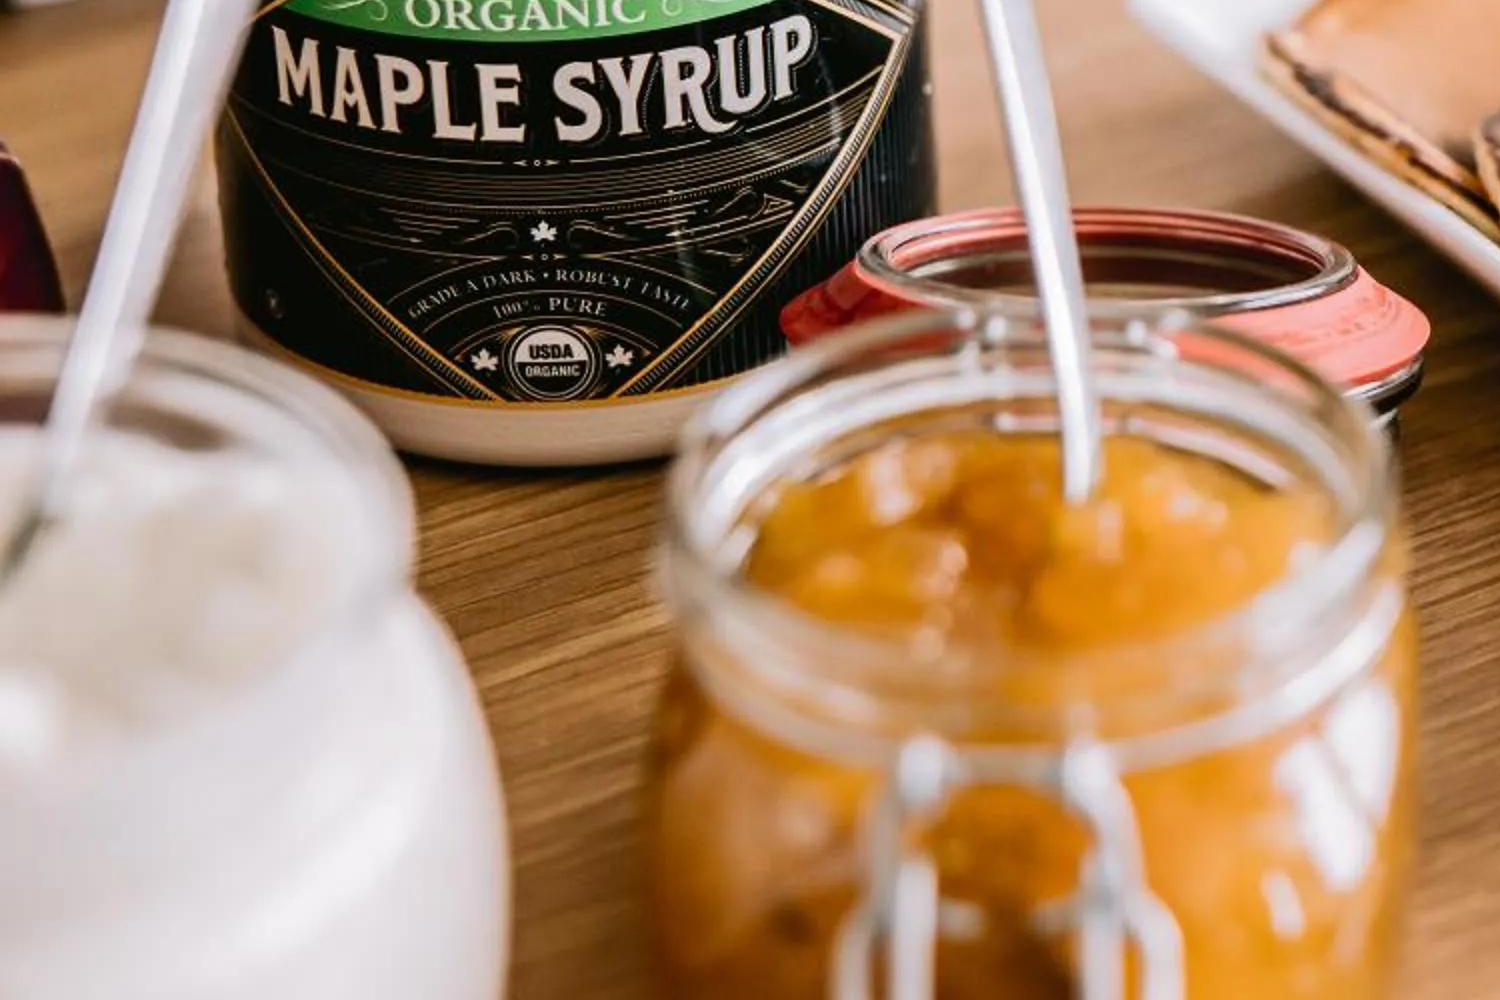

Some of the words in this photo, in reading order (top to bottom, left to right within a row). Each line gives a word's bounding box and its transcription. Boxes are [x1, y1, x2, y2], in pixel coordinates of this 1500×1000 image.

[272, 25, 526, 143] MAPLE
[552, 14, 814, 143] SYRUP
[408, 285, 459, 319] GRADE
[467, 279, 479, 293] A
[483, 269, 535, 289] DARK
[556, 269, 633, 291] ROBUST
[641, 281, 690, 311] TASTE
[548, 297, 607, 317] PURE
[528, 343, 574, 360] USDA
[525, 364, 581, 378] ORGANIC
